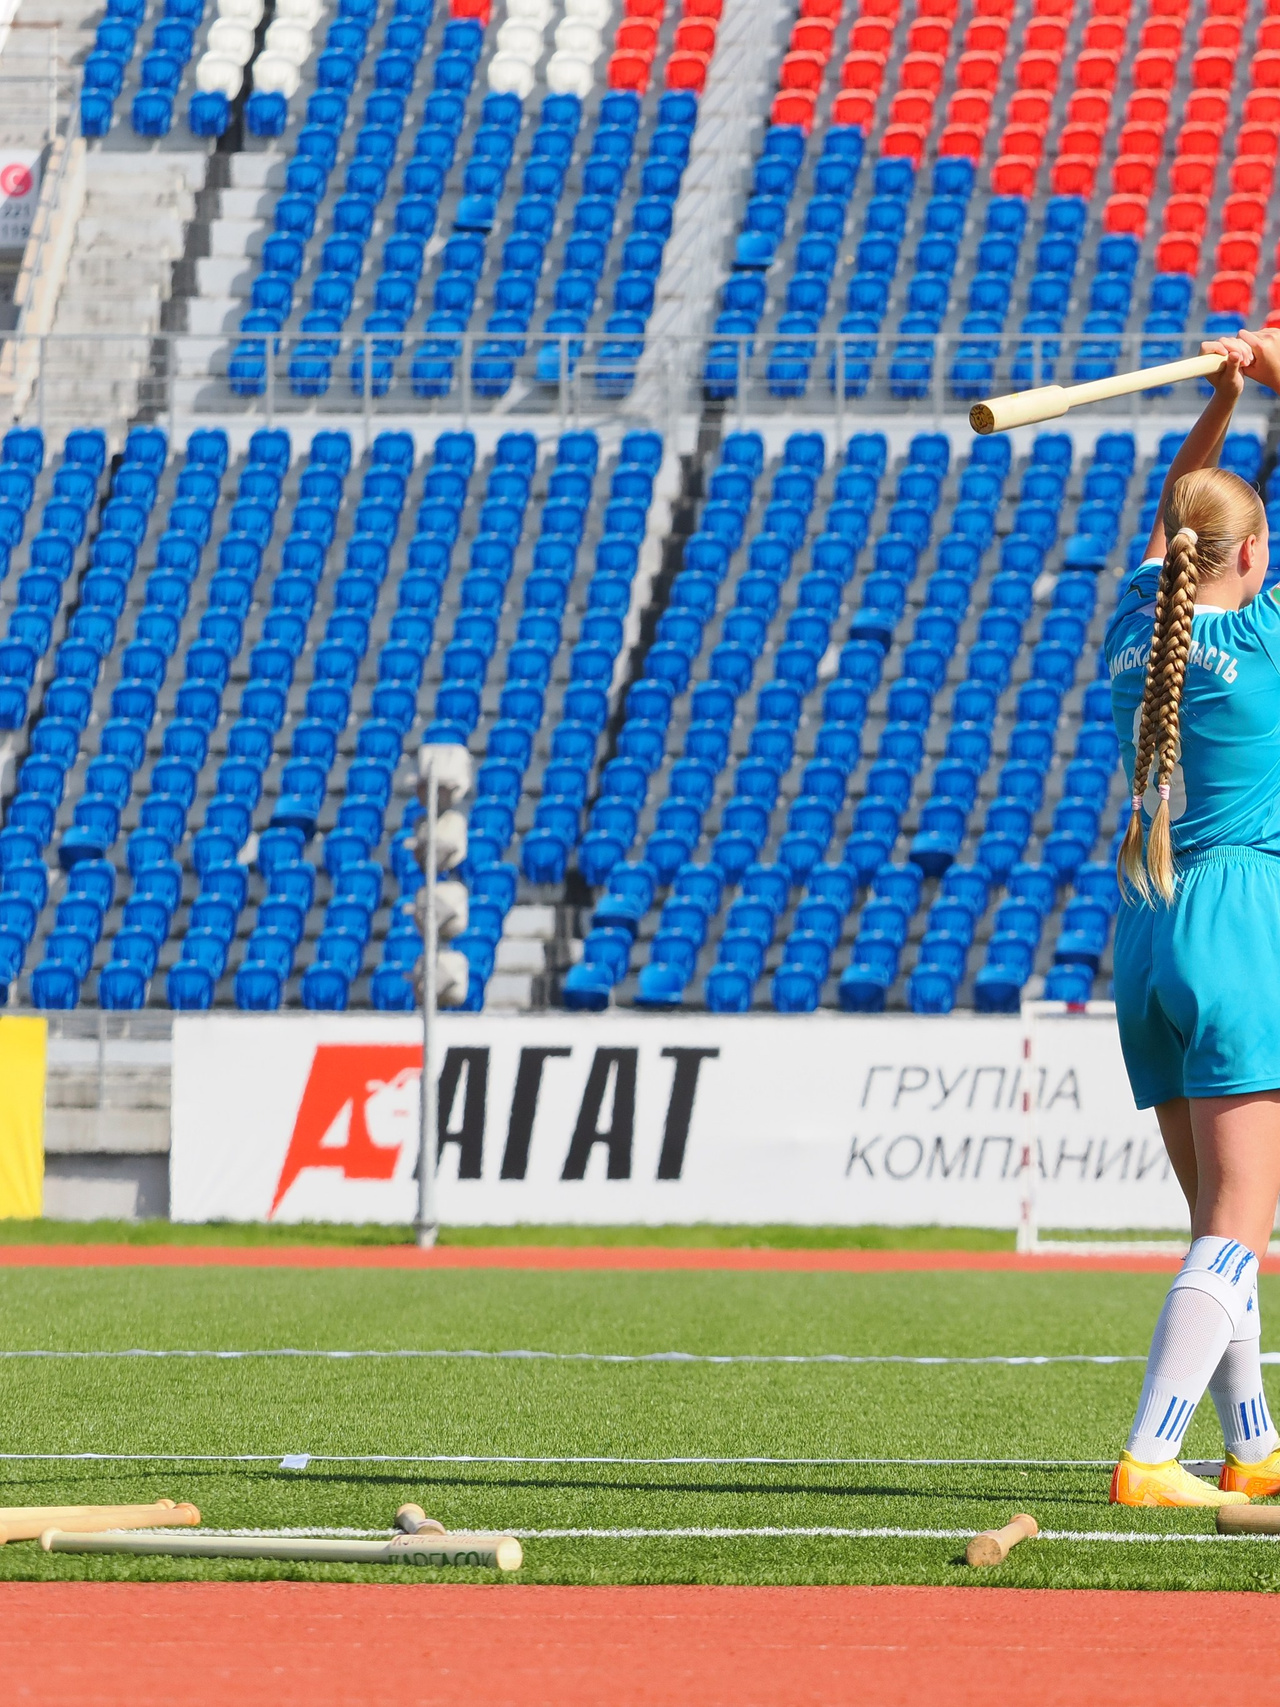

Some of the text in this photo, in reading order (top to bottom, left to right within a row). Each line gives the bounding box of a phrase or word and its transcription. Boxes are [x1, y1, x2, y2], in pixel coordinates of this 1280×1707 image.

[1187, 640, 1239, 684] ЛАСТЬ
[859, 1066, 1082, 1110] ГРУППА
[412, 1046, 721, 1180] АГАТ
